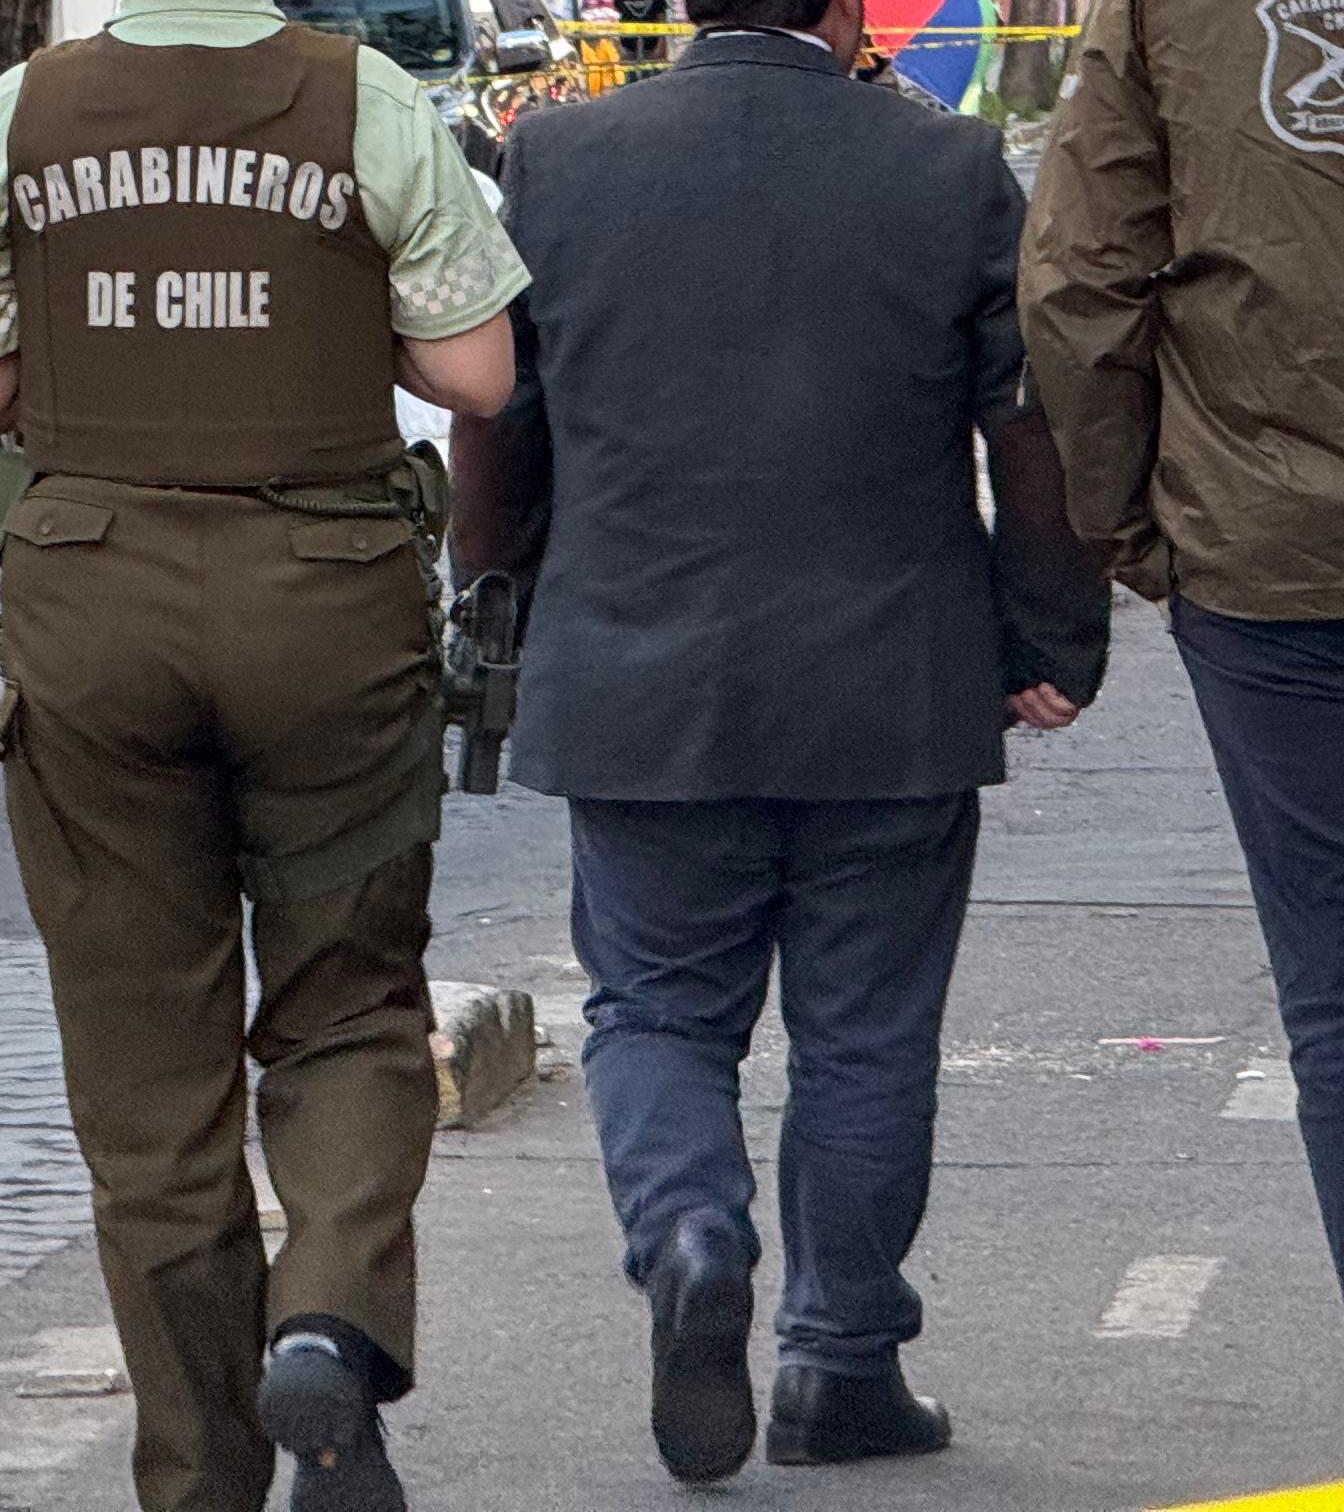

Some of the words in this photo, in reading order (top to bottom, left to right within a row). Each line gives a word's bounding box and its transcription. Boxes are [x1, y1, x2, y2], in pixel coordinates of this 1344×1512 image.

[13, 145, 355, 232] CARABINEROS
[87, 271, 136, 328] DE
[155, 269, 271, 329] CHILE
